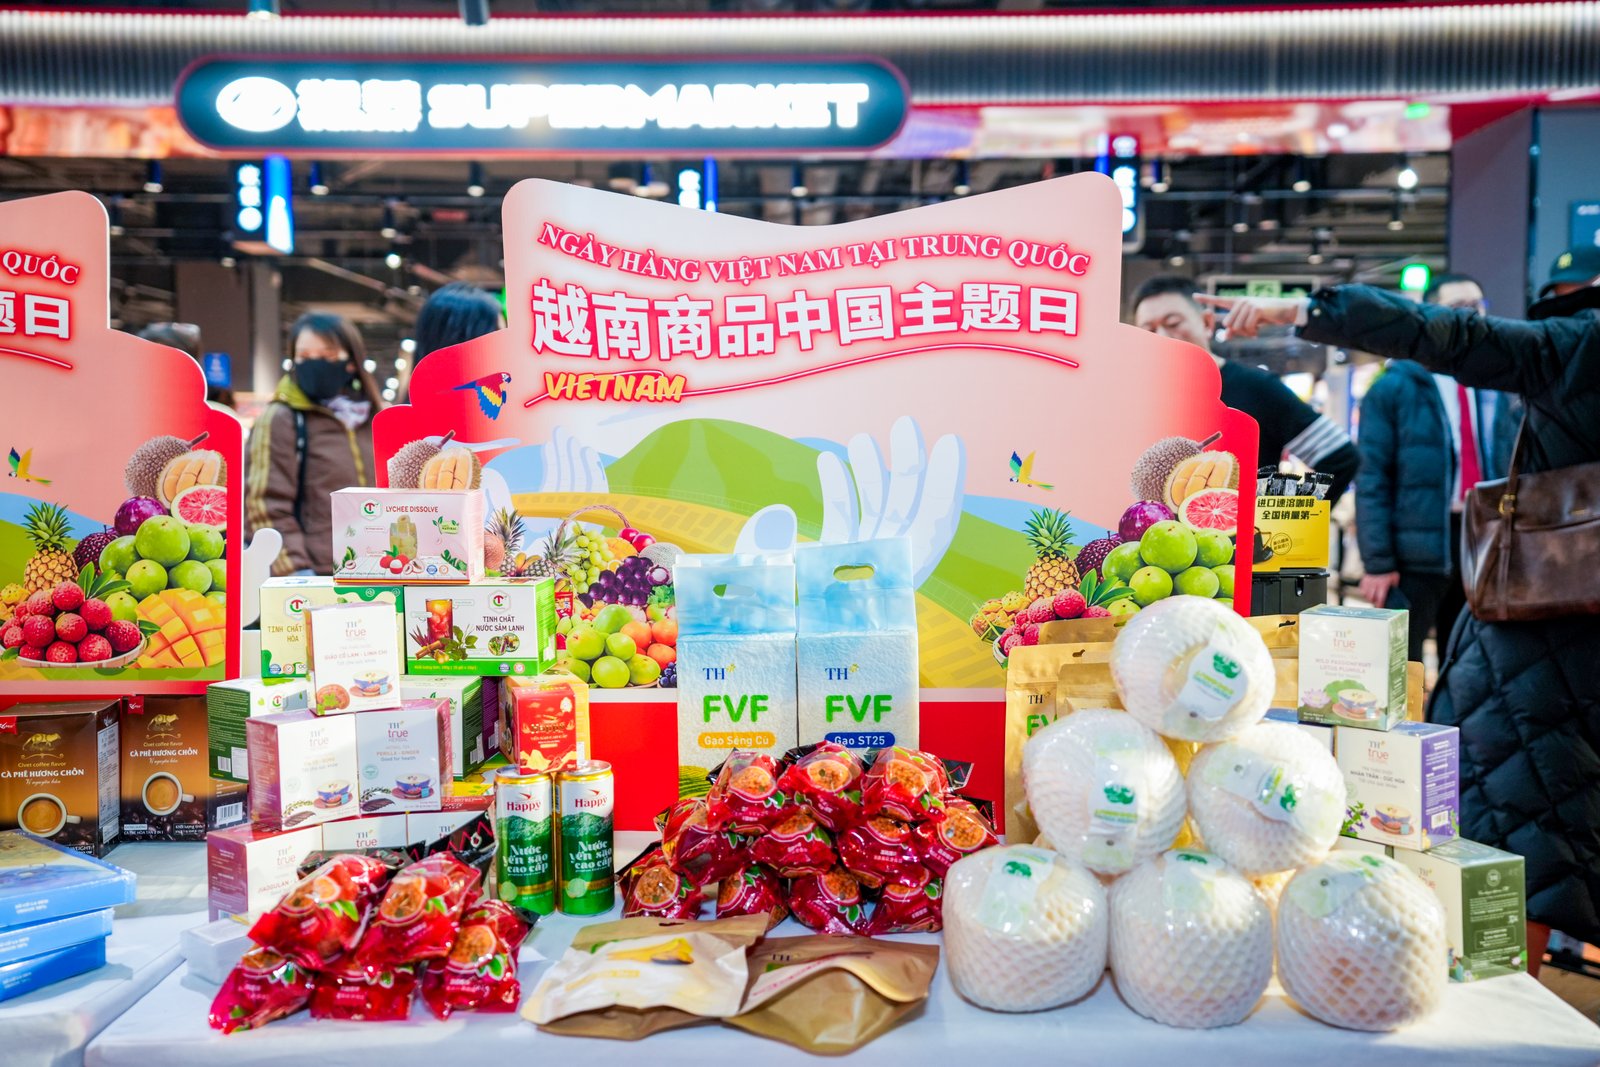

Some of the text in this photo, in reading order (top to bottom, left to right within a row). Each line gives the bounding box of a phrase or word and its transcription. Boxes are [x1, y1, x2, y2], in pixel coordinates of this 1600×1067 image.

[427, 82, 869, 129] SUPERMARKET
[539, 223, 1090, 286] NGÀY HÀNG VIỆT NAM TẠI TRUNG QUỐC
[2, 251, 79, 284] QUỐC
[532, 279, 1078, 360] 越南商品中国主题日
[545, 372, 686, 401] VIETNAM
[1257, 498, 1315, 508] 进口速溶咖啡
[385, 505, 439, 513] LYCHEE DISSOLVE
[345, 628, 367, 637] true
[1333, 638, 1356, 649] true
[703, 667, 725, 680] TH
[825, 667, 848, 680] TH
[1028, 694, 1043, 704] TH
[702, 694, 769, 723] FVF
[825, 694, 893, 723] FVF
[387, 728, 409, 738] true
[858, 735, 885, 746] ST25
[130, 749, 139, 757] CÀ
[1367, 748, 1389, 760] true
[1, 769, 12, 778] CÀ
[13, 769, 28, 778] PHÊ
[507, 801, 541, 812] Happy
[575, 795, 607, 809] Happy
[356, 838, 378, 848] true
[277, 854, 296, 866] true
[575, 861, 595, 869] cao
[507, 865, 527, 873] cao
